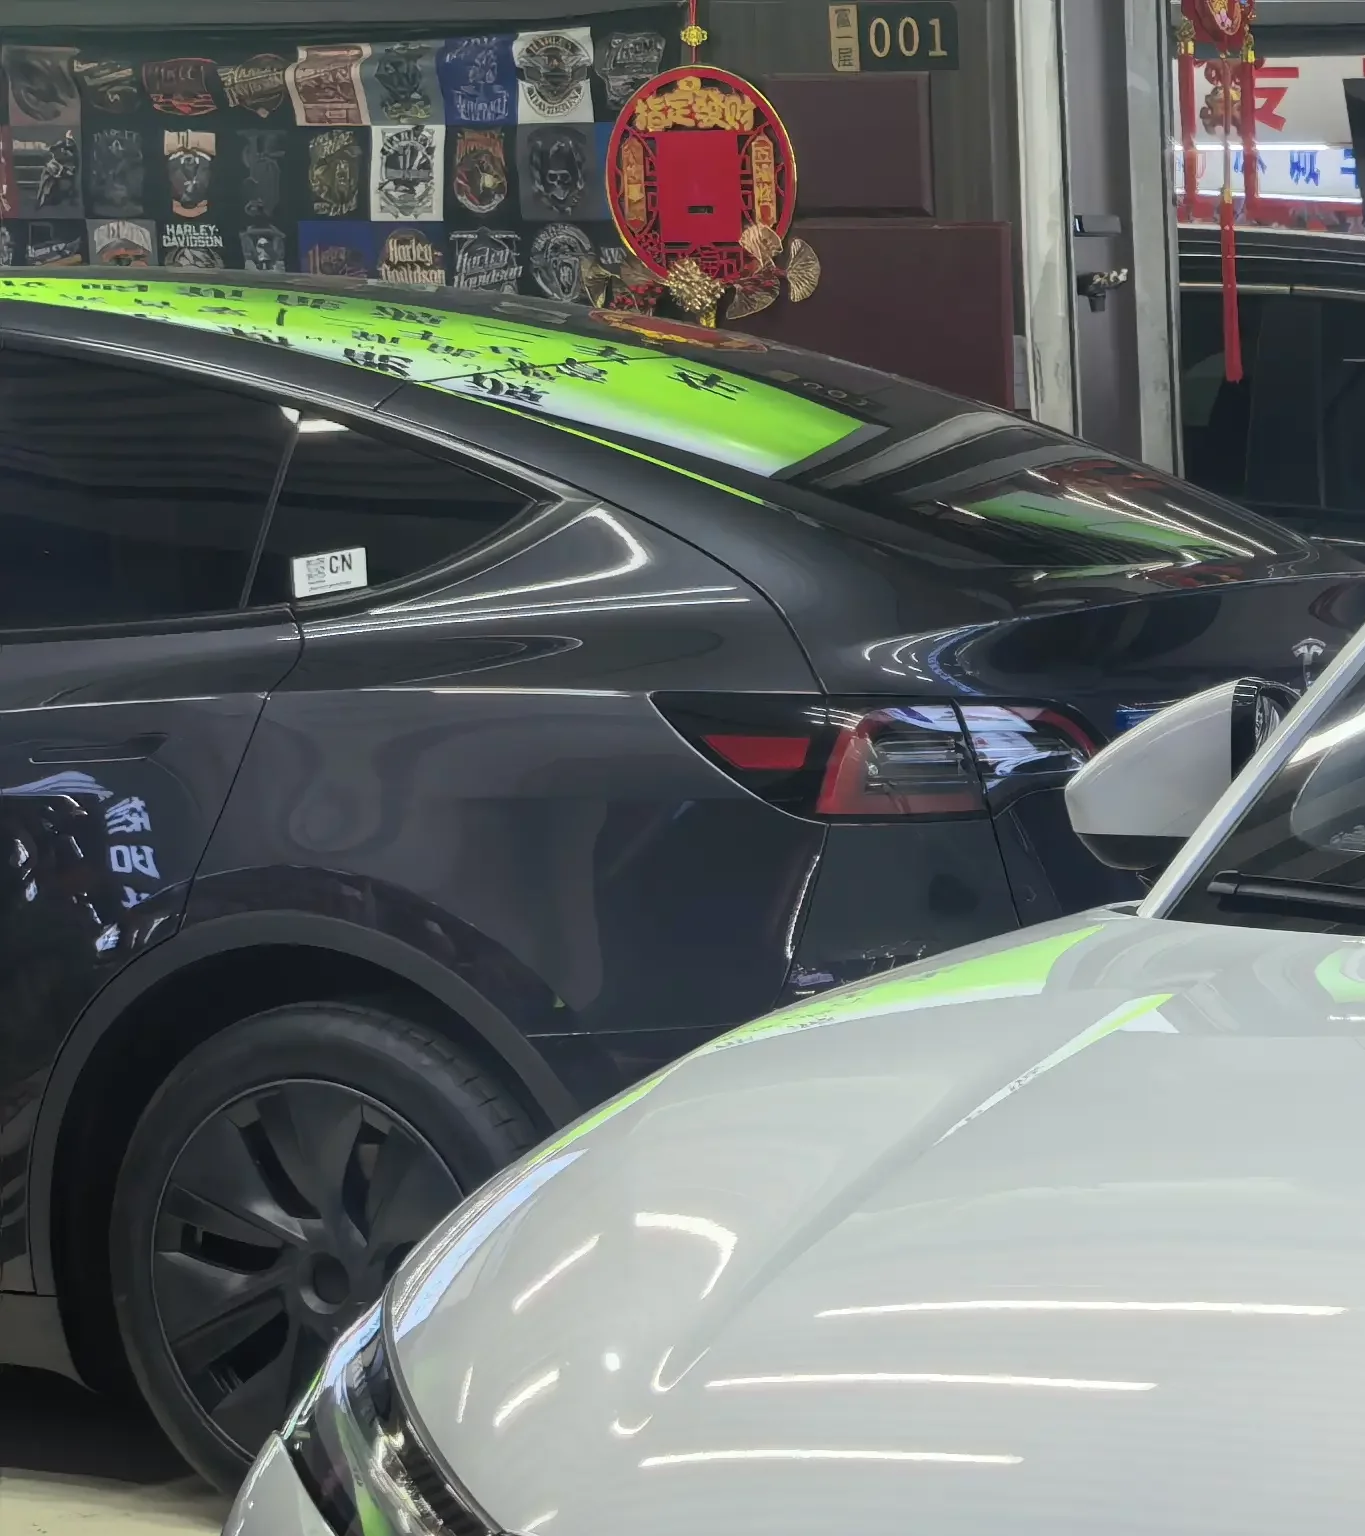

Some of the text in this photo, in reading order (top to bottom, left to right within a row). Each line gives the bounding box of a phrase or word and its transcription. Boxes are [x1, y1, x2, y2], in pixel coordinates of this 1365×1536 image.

[869, 16, 948, 58] 001
[162, 235, 224, 248] DAVIDSON
[328, 551, 353, 574] CN
